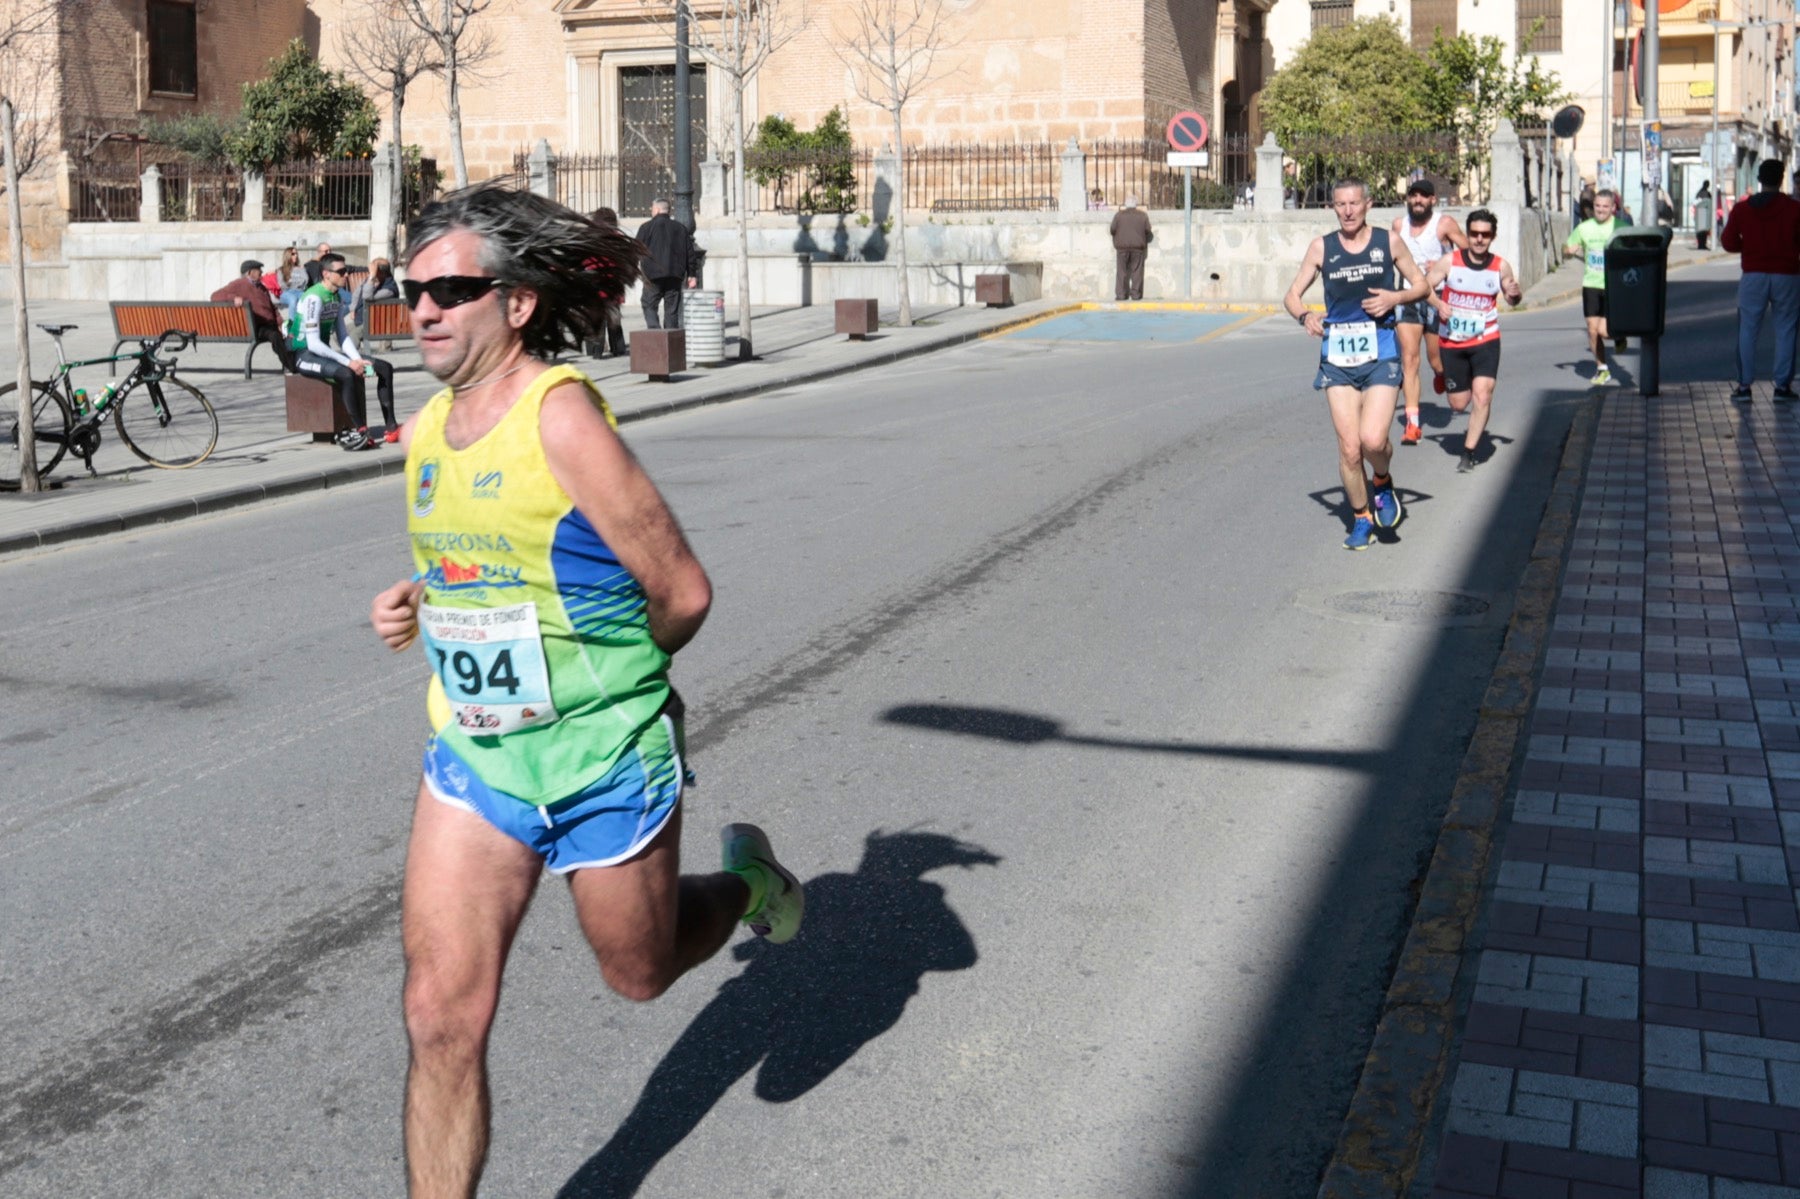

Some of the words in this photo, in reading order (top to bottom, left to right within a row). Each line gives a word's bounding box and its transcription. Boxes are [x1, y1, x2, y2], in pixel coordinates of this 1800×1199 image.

[1452, 317, 1477, 333] 911
[1338, 336, 1370, 352] 112
[479, 613, 492, 626] DE
[434, 647, 520, 696] 794
